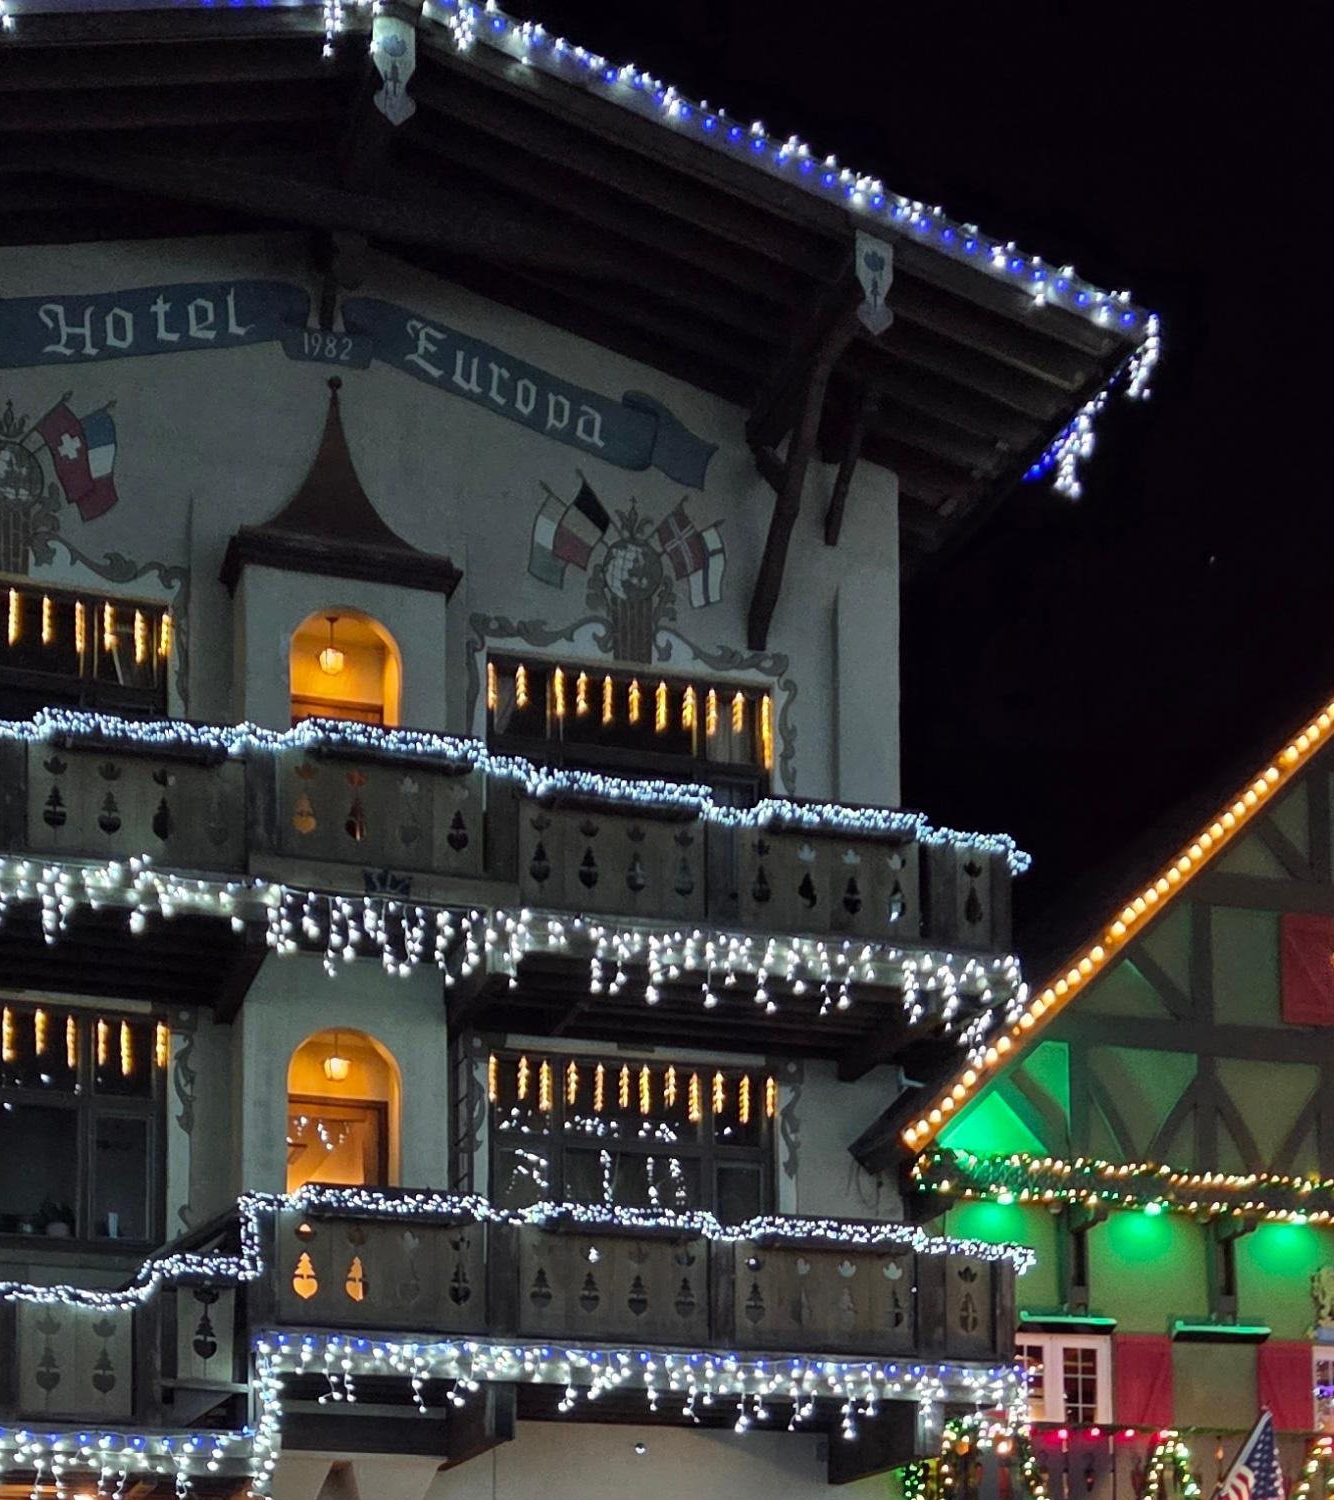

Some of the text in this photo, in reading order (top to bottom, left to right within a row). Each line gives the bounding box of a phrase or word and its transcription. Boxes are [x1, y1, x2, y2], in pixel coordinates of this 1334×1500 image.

[38, 286, 606, 449] Hotel Europa
[302, 331, 354, 362] 1982
